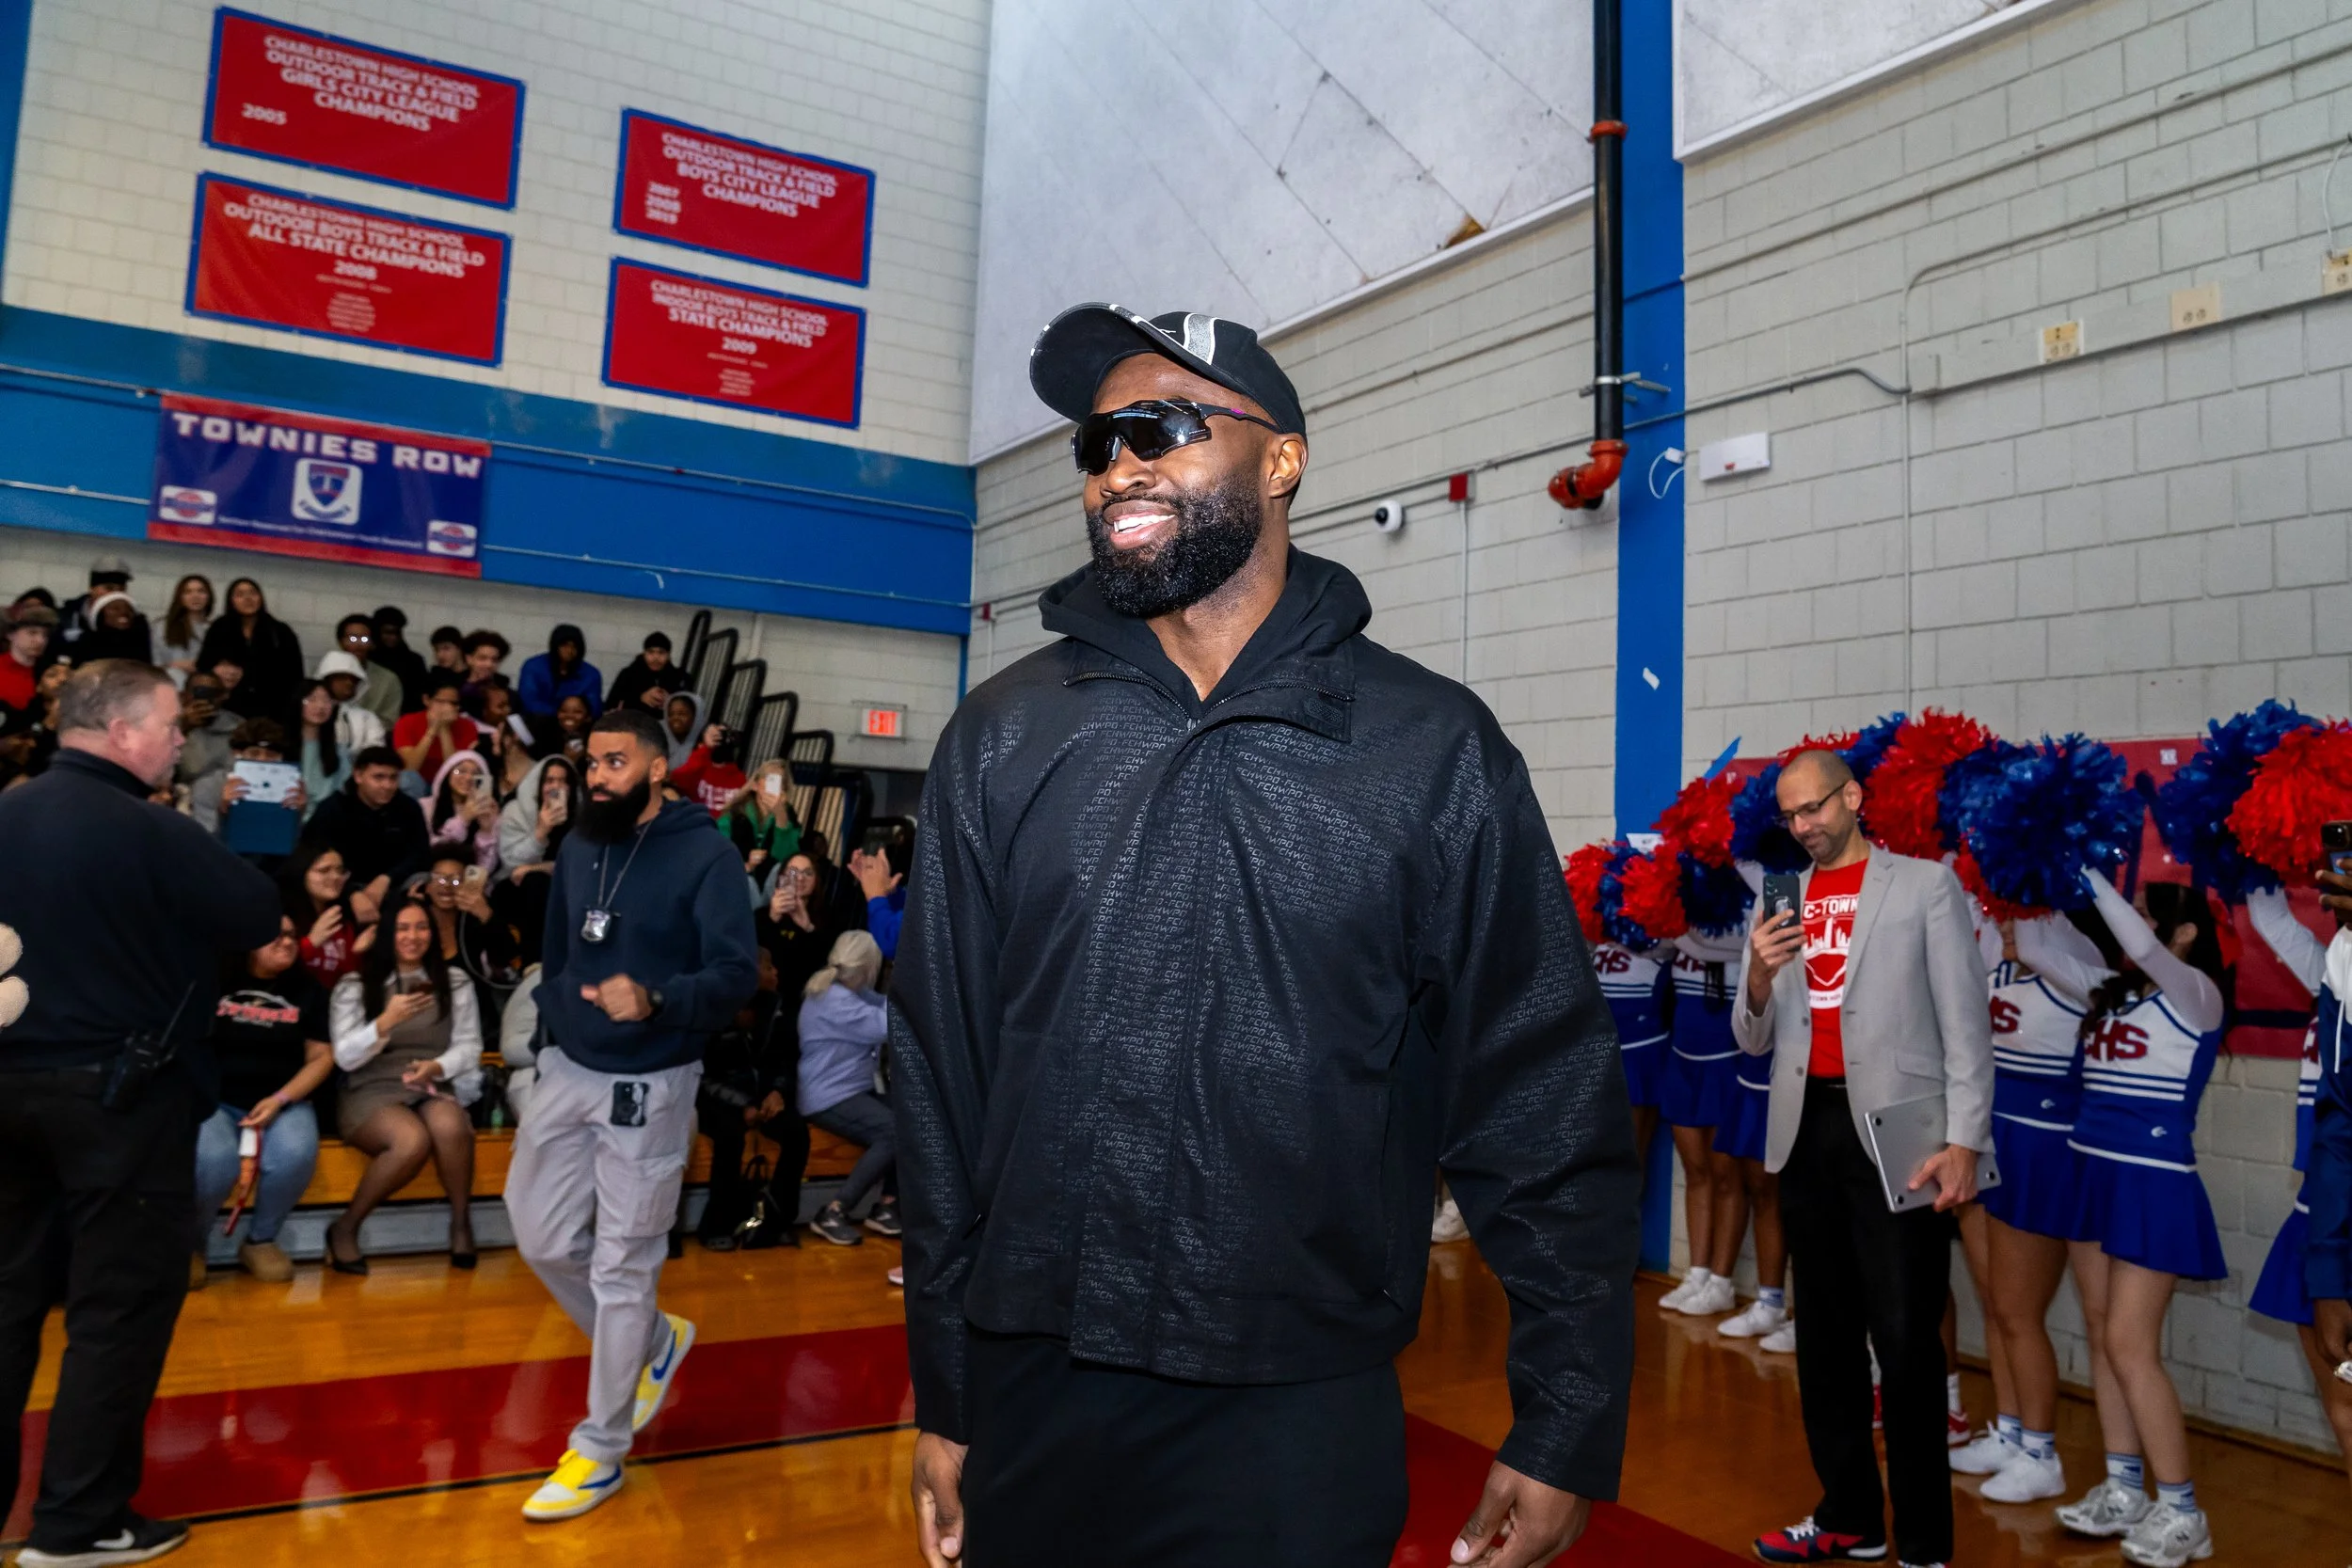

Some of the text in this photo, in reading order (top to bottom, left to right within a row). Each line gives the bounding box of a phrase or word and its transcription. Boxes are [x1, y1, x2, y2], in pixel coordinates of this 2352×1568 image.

[264, 50, 357, 83] OUTDOOR
[359, 71, 416, 97] TRACK
[431, 88, 477, 110] FIELD
[280, 68, 460, 122] GIRLS CITY LEAGUE
[314, 91, 431, 132] CHAMPIONS
[662, 145, 737, 176] OUTDOOR
[738, 161, 784, 184] TRACK
[798, 177, 836, 198] FIELD
[676, 162, 820, 209] BOYS CITY LEAGUE
[702, 183, 798, 217] CHAMPIONS
[224, 201, 316, 235] OUTDOOR
[318, 218, 365, 242] BOYS
[368, 230, 421, 255] TRACK
[438, 244, 486, 267] FIELD
[247, 222, 465, 278] ALL STATE CHAMPIONS
[669, 306, 814, 349] STATE CHAMPIONS
[171, 411, 483, 479] TOWNIES ROW
[1804, 897, 1859, 919] C-TOWN
